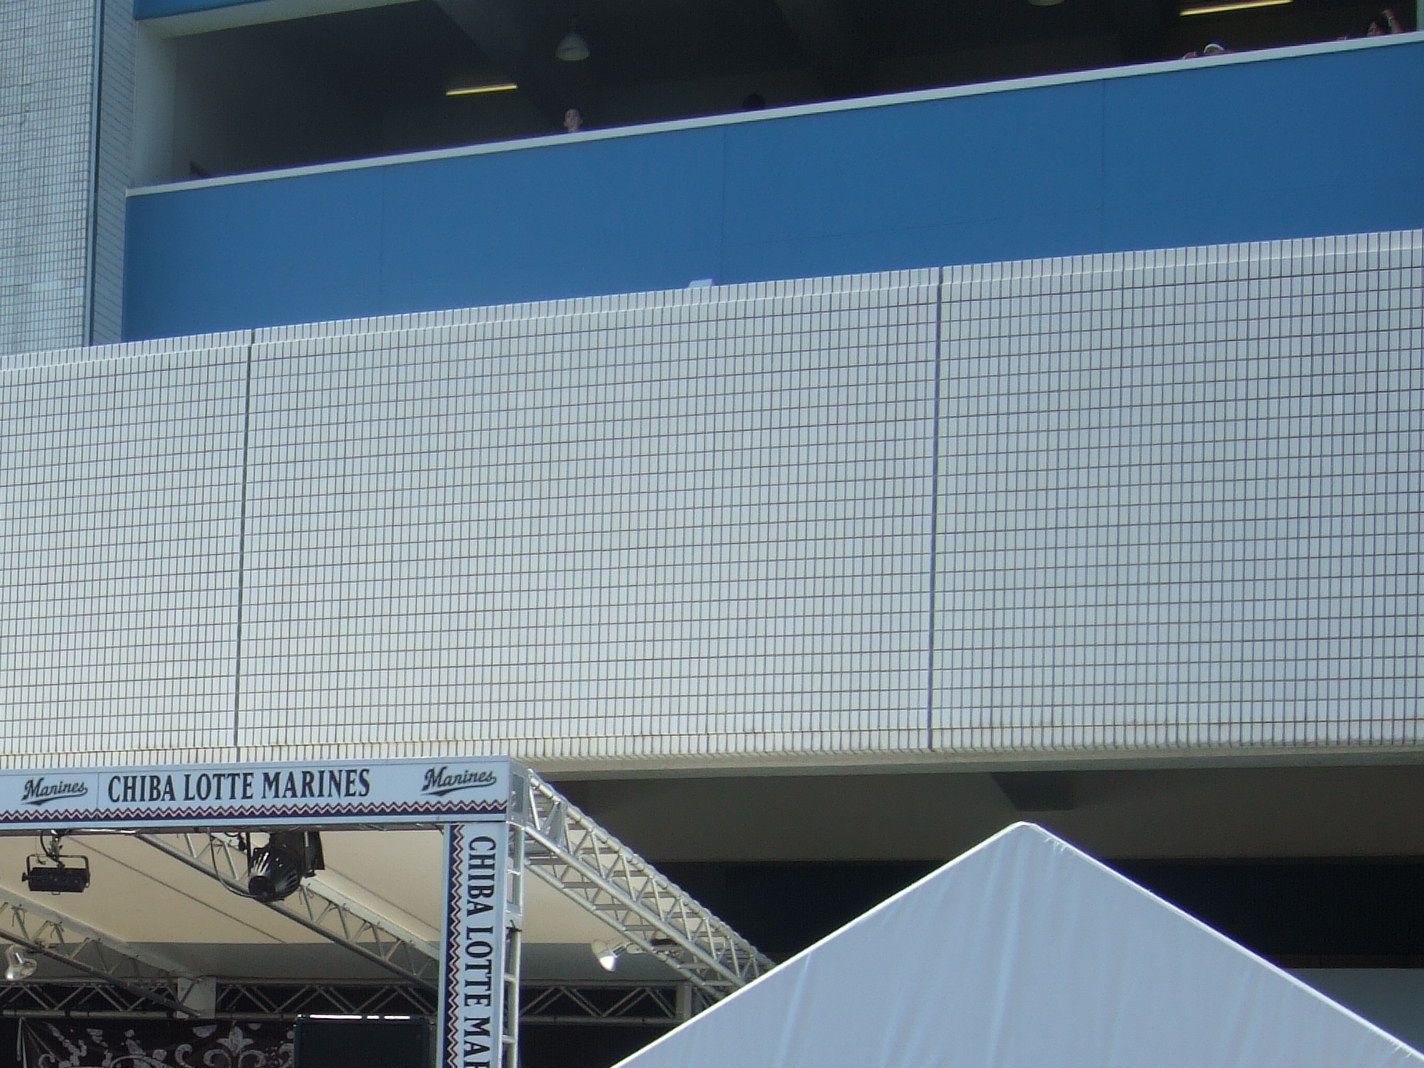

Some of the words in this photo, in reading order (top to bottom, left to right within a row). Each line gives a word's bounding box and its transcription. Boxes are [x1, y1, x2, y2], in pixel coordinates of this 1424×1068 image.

[20, 777, 88, 806] Marines
[108, 774, 176, 802] CHIBA
[183, 772, 254, 801] LOTTE
[262, 768, 371, 799] MARINES
[420, 766, 498, 796] Marines
[466, 835, 497, 918] CHIBA
[464, 926, 494, 1007] LOTTE
